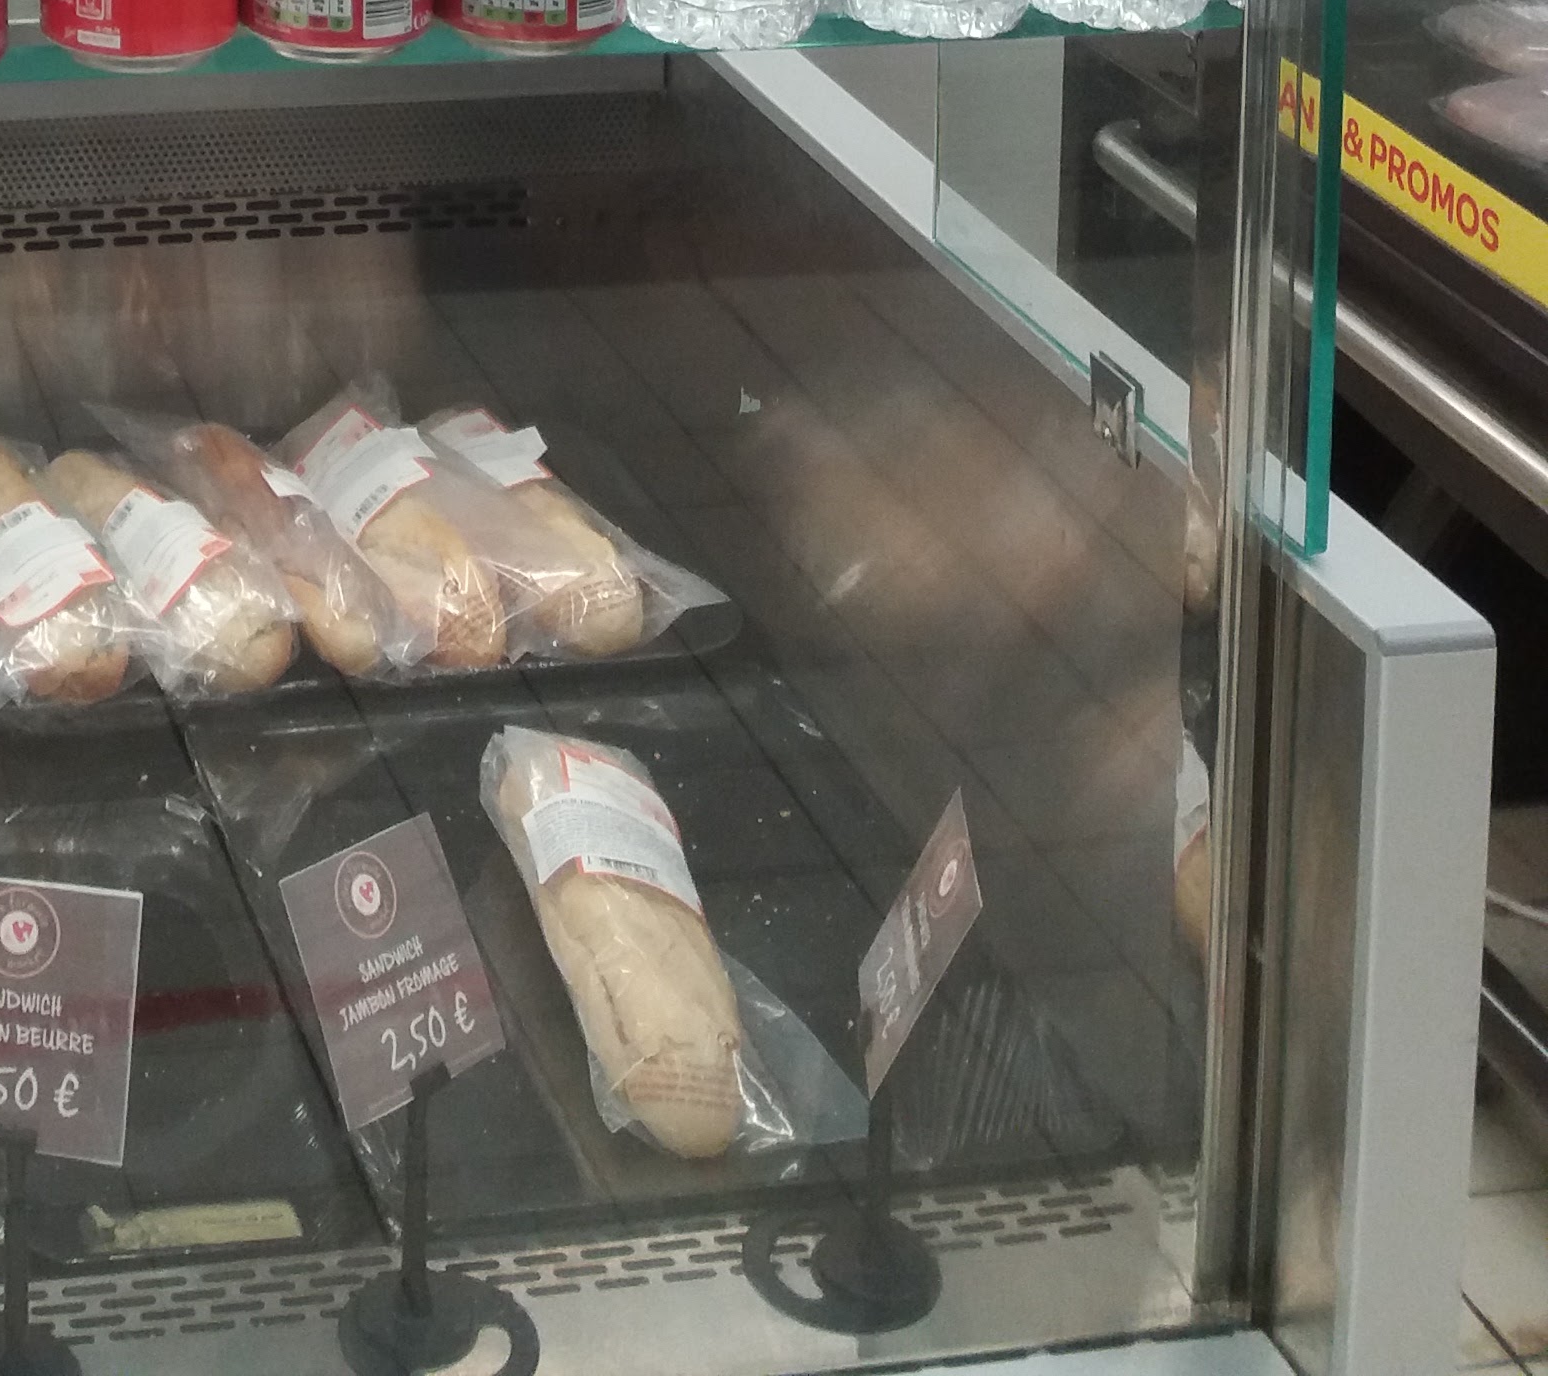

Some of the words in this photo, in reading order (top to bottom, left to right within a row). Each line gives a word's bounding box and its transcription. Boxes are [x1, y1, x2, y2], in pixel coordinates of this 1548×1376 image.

[1370, 133, 1501, 253] PROMOS
[358, 935, 424, 984] SANDWICH
[339, 984, 397, 1032] JAMBON
[397, 952, 460, 1000] FROMAGE
[16, 1024, 95, 1055] BEURRE
